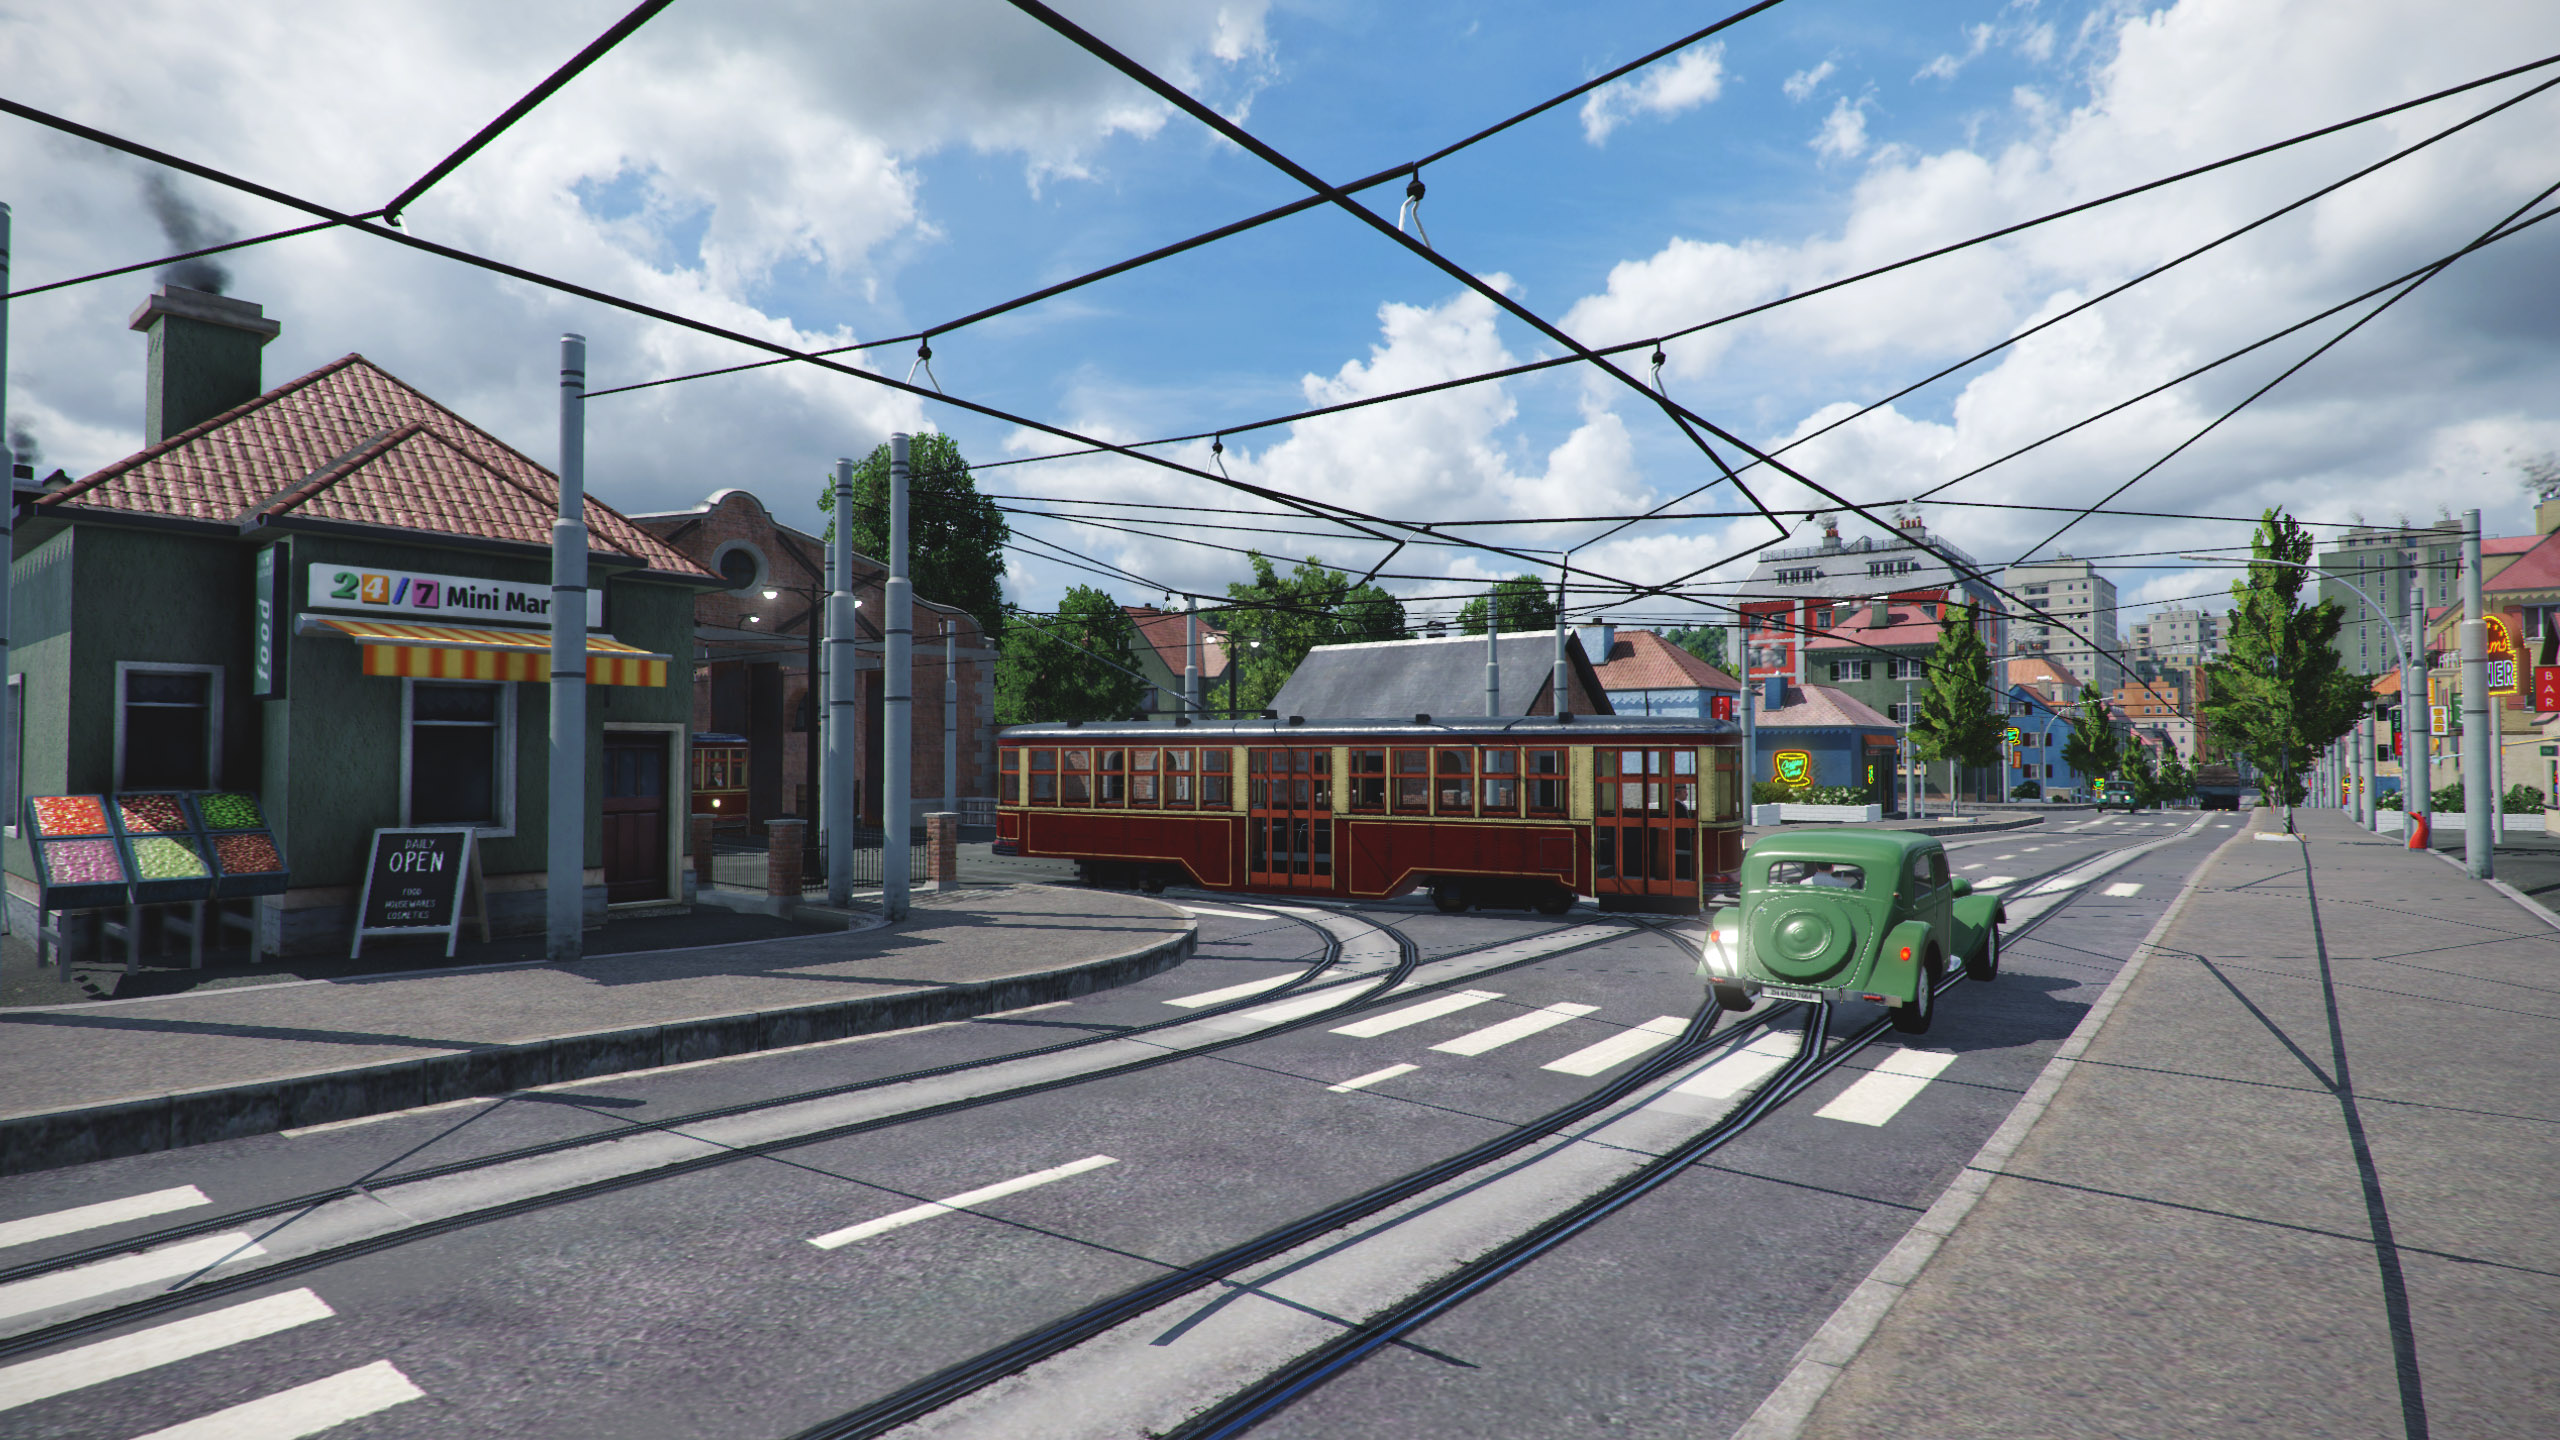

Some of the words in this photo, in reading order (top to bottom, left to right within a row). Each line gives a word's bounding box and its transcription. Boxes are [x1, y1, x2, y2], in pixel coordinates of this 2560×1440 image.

[330, 571, 439, 608] 24/7
[447, 586, 499, 611] Mini
[505, 592, 551, 614] Mar
[257, 598, 270, 680] food
[2544, 671, 2555, 708] BAR
[389, 851, 444, 873] OPEN
[405, 839, 435, 849] DAILY
